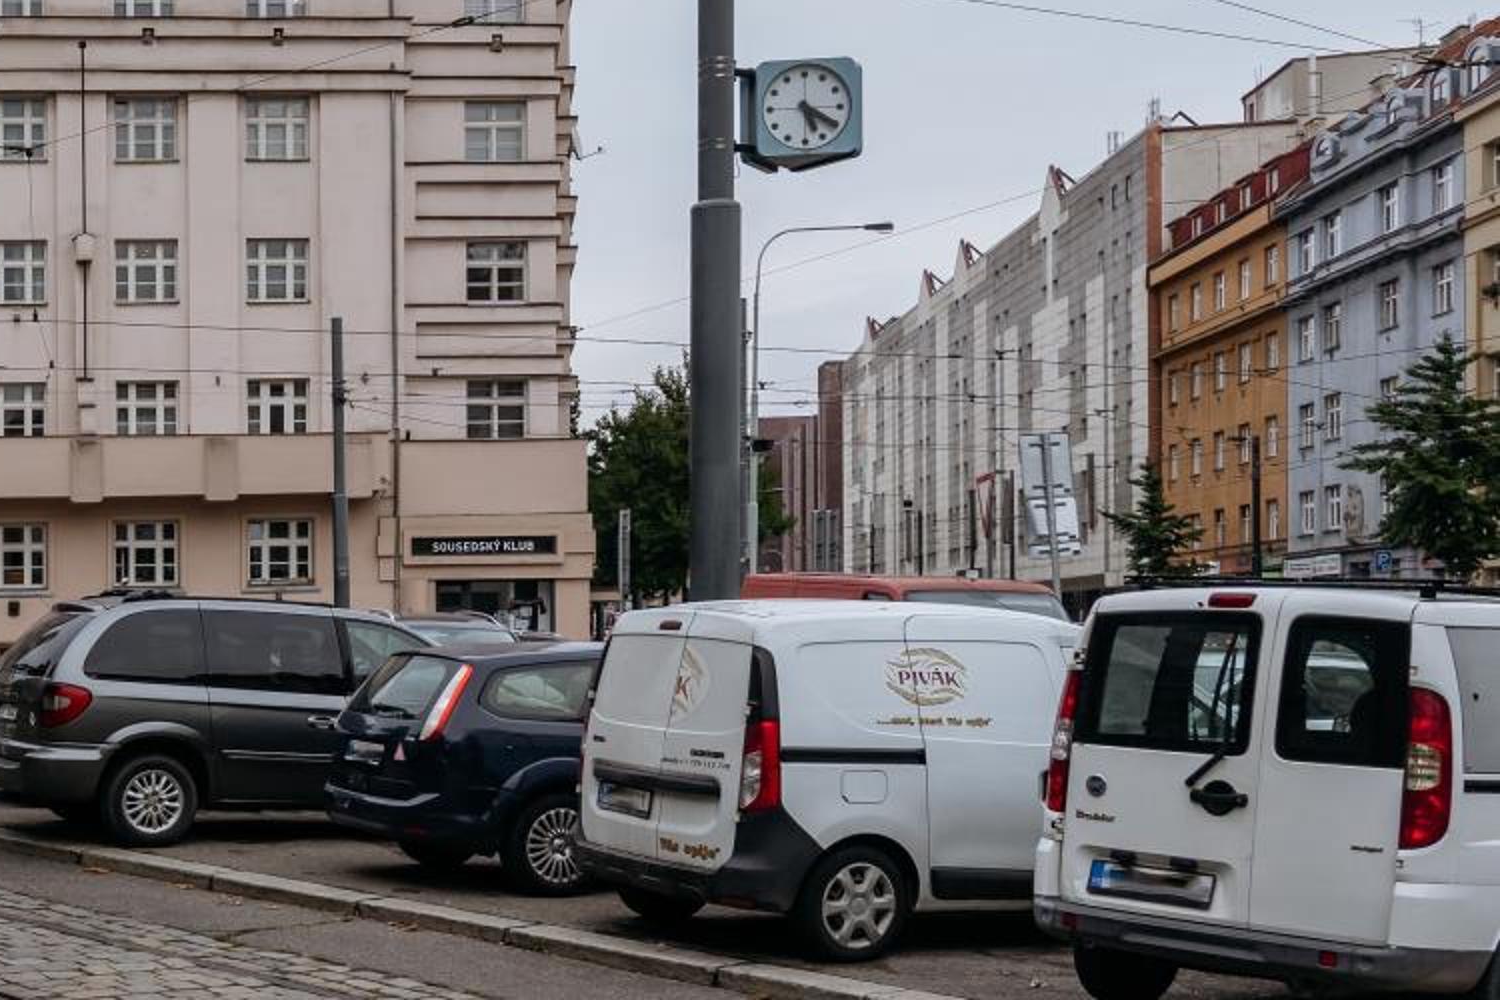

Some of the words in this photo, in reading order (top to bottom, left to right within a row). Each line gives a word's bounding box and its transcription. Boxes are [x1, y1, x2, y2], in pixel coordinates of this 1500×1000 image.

[432, 538, 500, 552] SOUSEDSKÝ
[503, 540, 535, 551] KLUB
[898, 667, 962, 689] PIVÁK
